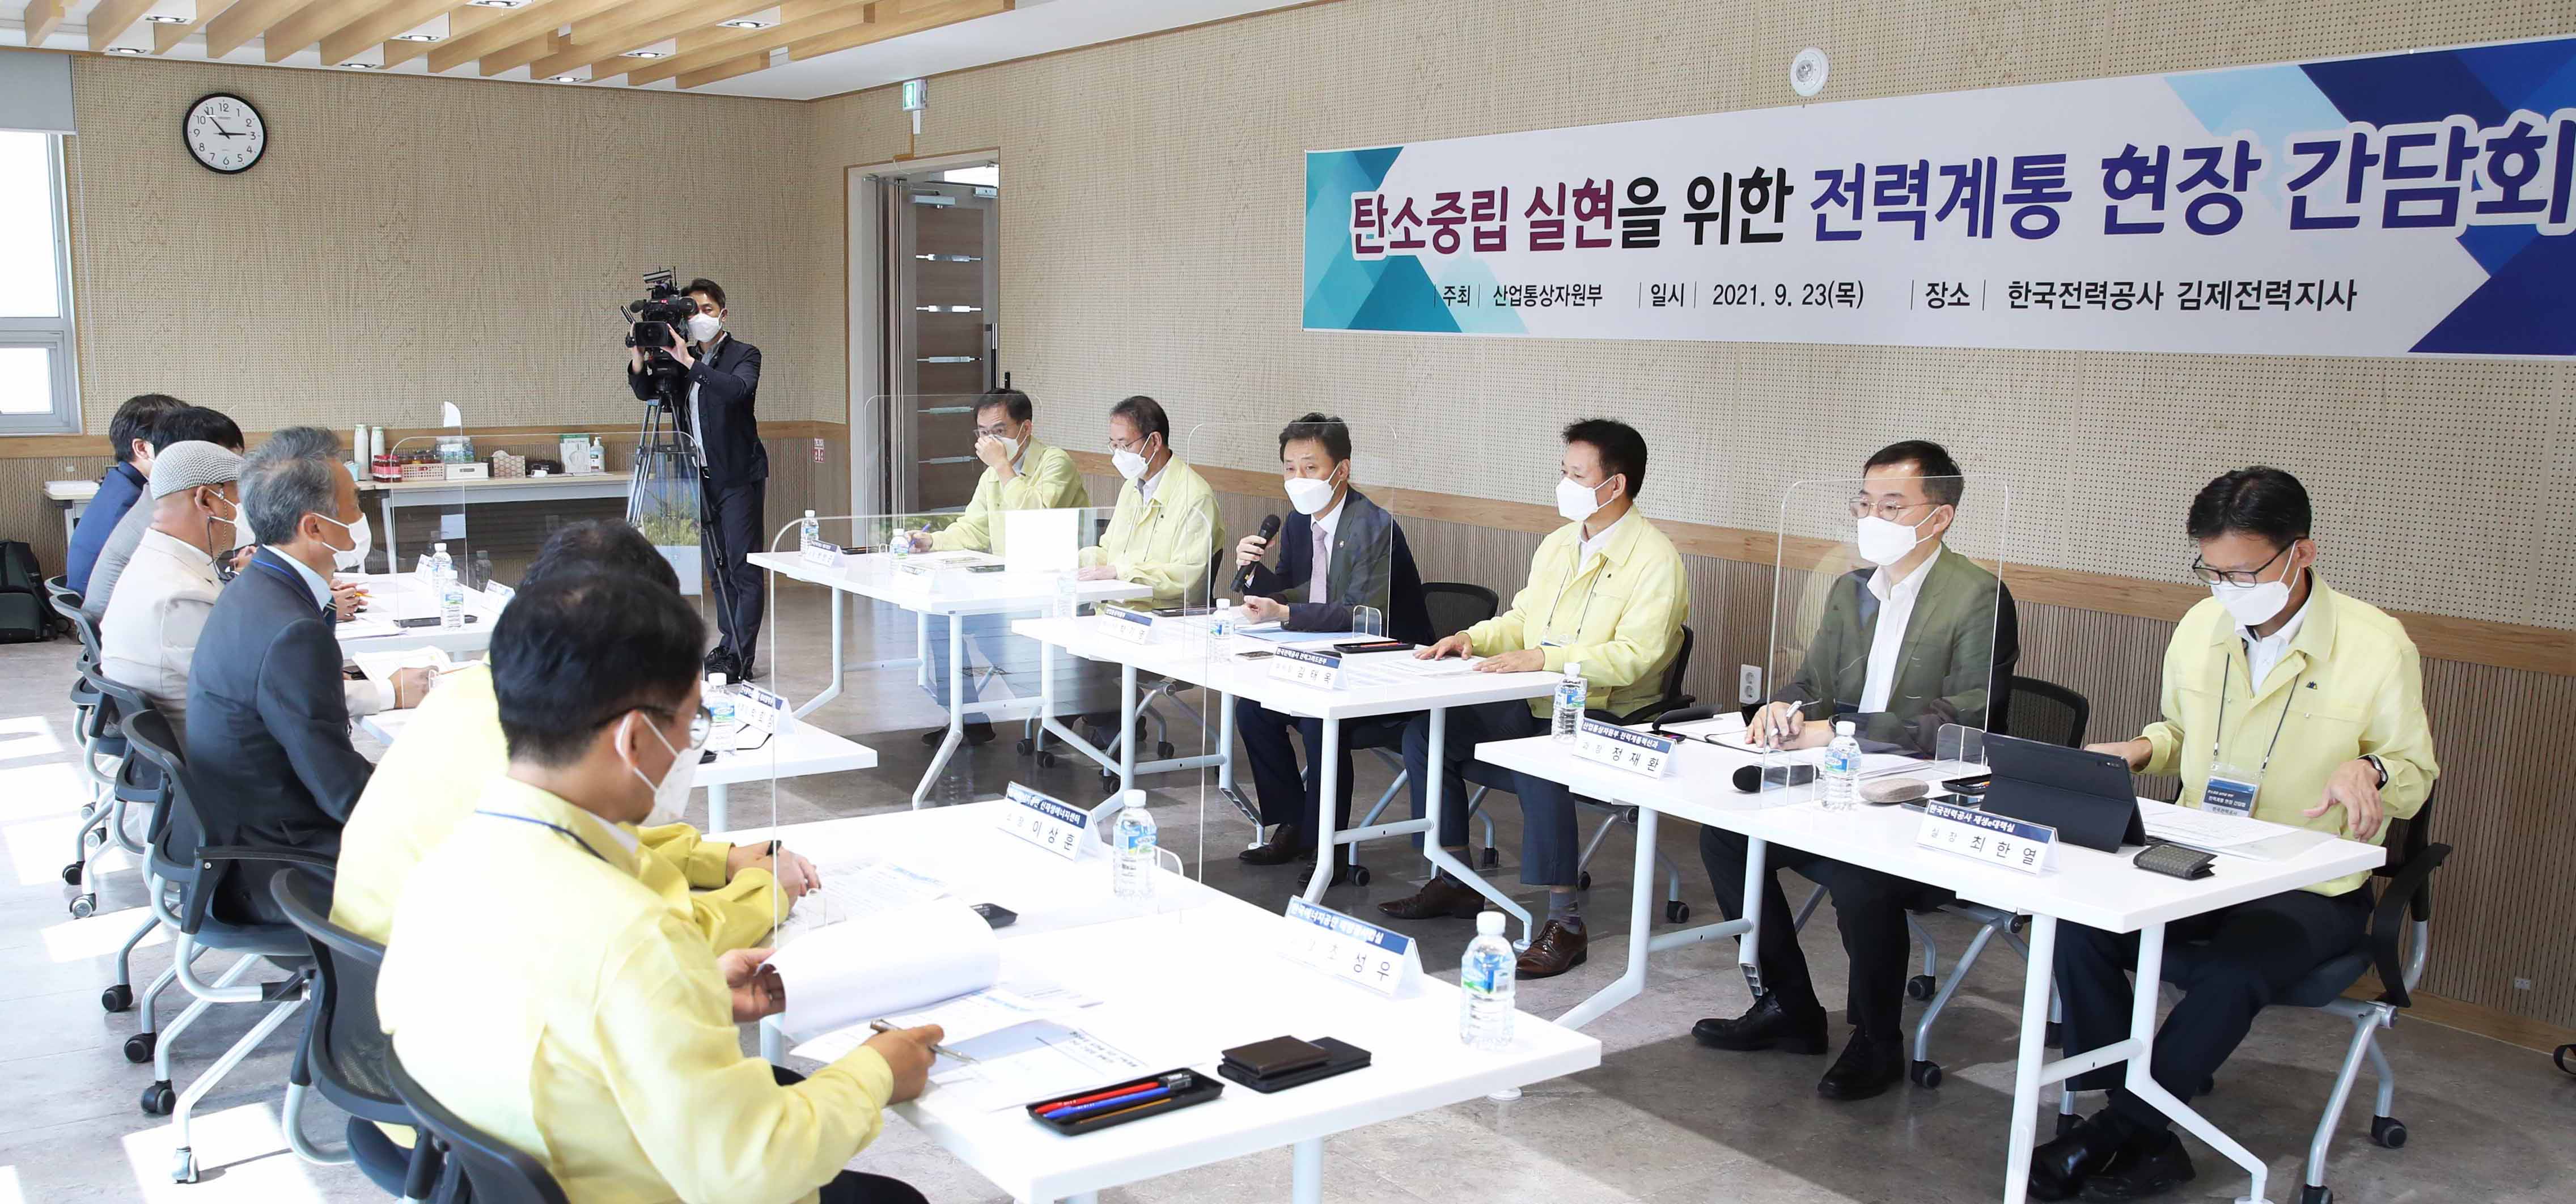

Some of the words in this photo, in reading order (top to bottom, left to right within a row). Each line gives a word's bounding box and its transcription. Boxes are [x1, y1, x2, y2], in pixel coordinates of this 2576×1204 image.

[219, 103, 229, 112] 12
[236, 108, 240, 117] 1
[196, 116, 206, 125] 10
[245, 118, 252, 127] 2
[193, 129, 200, 137] 9
[250, 132, 256, 140] 3
[199, 143, 205, 151] 8
[1354, 186, 1508, 255] 탄소중립
[1524, 176, 1667, 252] 실현을
[1683, 166, 1794, 245] 위한
[1810, 143, 2073, 241] 전력계통
[2101, 140, 2262, 236] 현장
[2287, 120, 2576, 230] 간담회
[1443, 285, 1471, 307] 주최
[1493, 283, 1603, 307] 산업통상자원부
[1651, 283, 1684, 307] 일시
[1713, 284, 1765, 307] 2021.
[1775, 283, 1792, 307] 9.
[1802, 280, 1863, 309] 23(목)
[1925, 281, 1971, 309] 장소
[2009, 281, 2164, 311] 한국전력공사
[2177, 279, 2358, 312] 김제전력지사
[1583, 722, 1619, 738] 산업통상자원부
[1929, 804, 1972, 822] 한국전력공사
[1973, 815, 2016, 833] 재생e대책실
